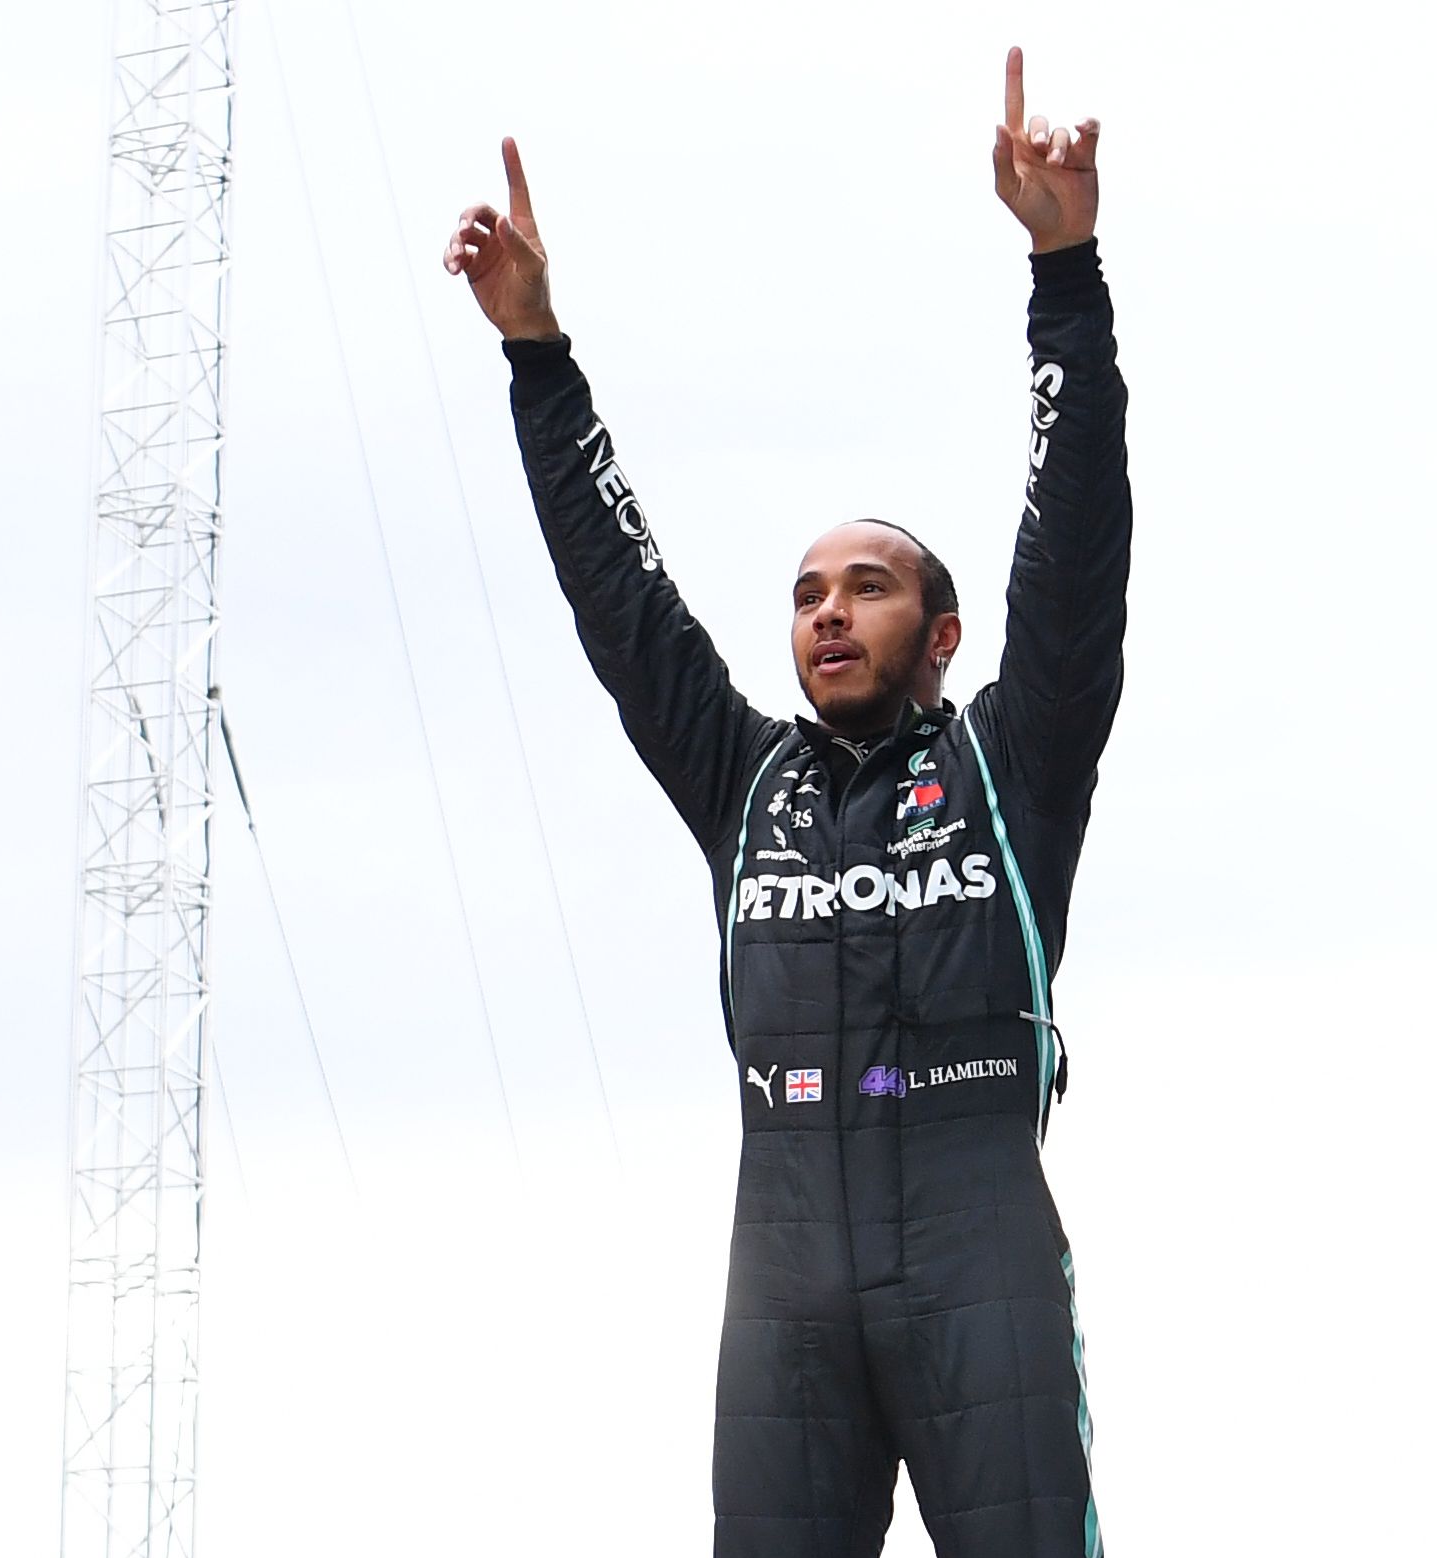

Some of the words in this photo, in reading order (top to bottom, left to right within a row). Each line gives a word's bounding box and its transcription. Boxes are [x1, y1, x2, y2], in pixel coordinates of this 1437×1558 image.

[575, 420, 663, 573] INEOS
[736, 853, 997, 922] PETRONAS
[859, 1065, 907, 1098] 44
[908, 1071, 925, 1089] L.
[929, 1059, 1017, 1085] HAMILTON
